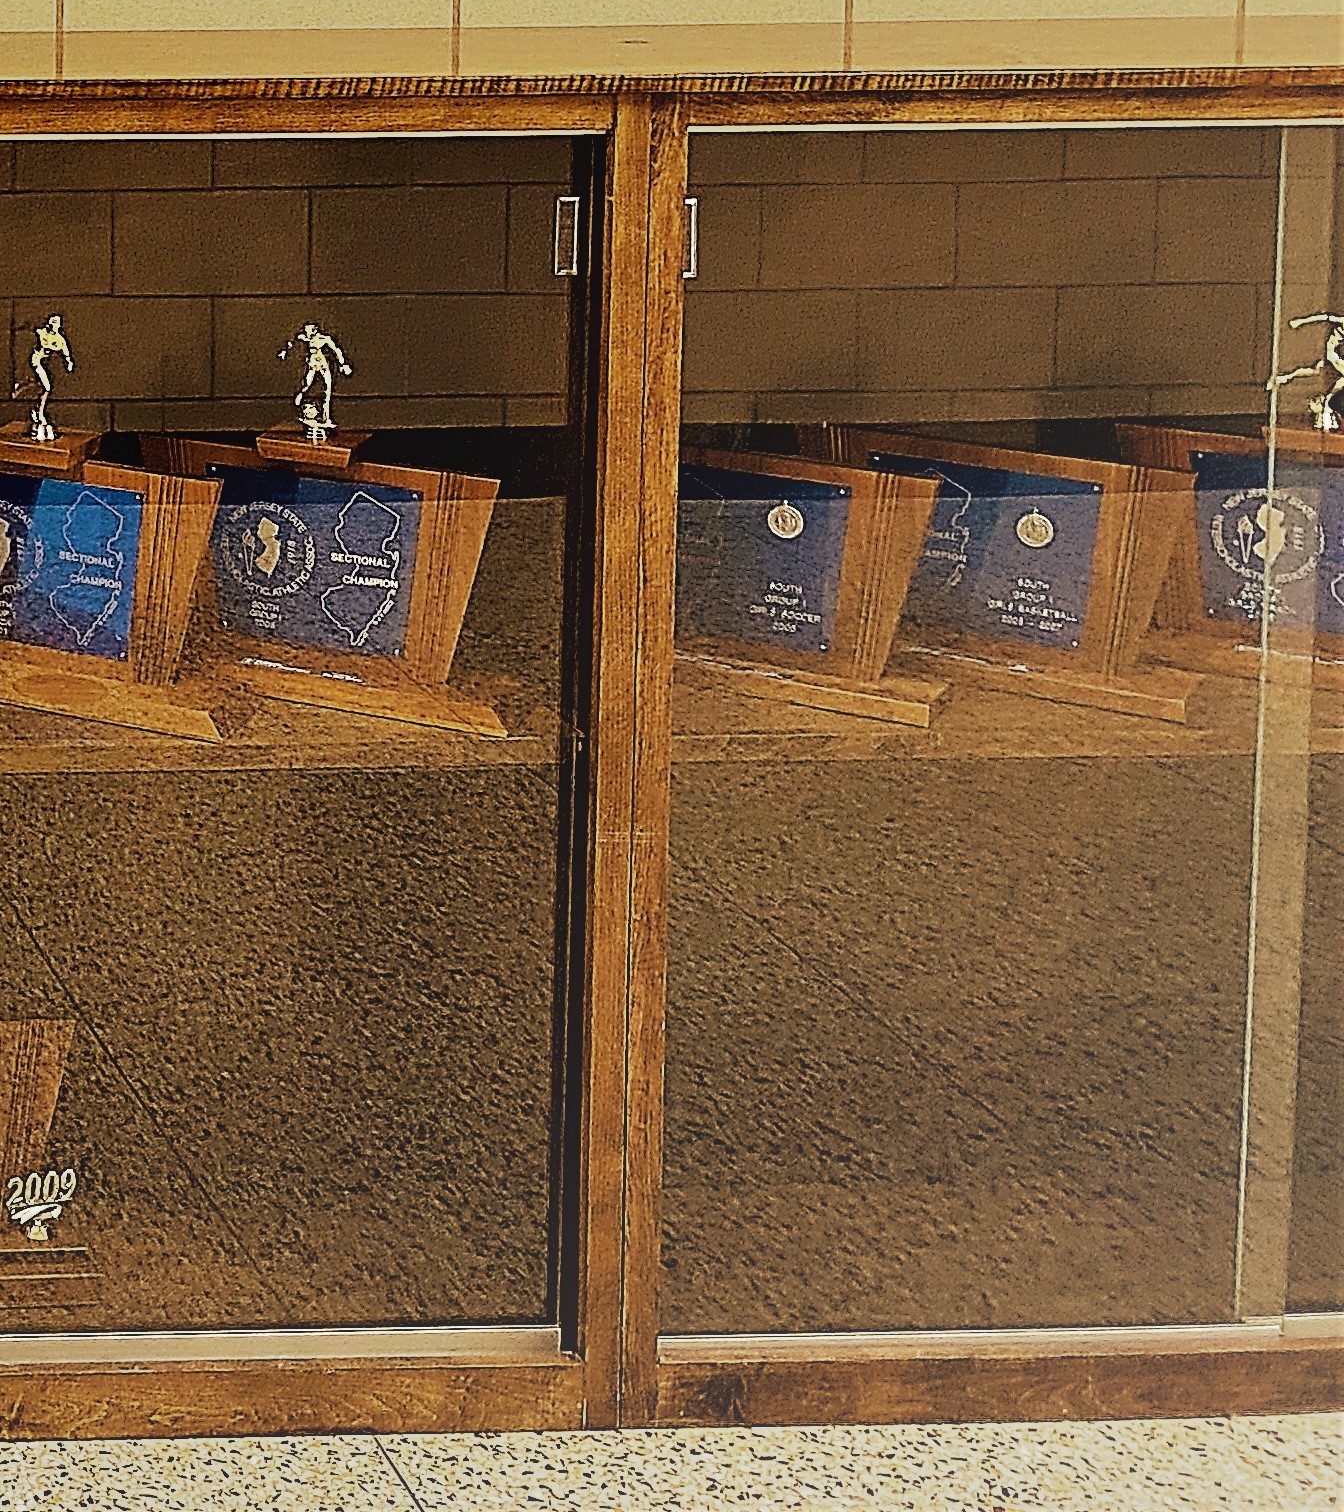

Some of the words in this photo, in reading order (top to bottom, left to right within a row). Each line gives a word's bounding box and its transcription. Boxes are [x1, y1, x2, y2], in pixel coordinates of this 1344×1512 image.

[282, 508, 308, 534] STATE
[59, 551, 115, 568] SECTIONAL
[330, 552, 391, 568] SECTIONAL
[69, 574, 122, 589] CHAMPION
[342, 575, 398, 589] CHAMPION
[251, 601, 280, 612] SOUTH
[6, 1169, 77, 1209] 2009
